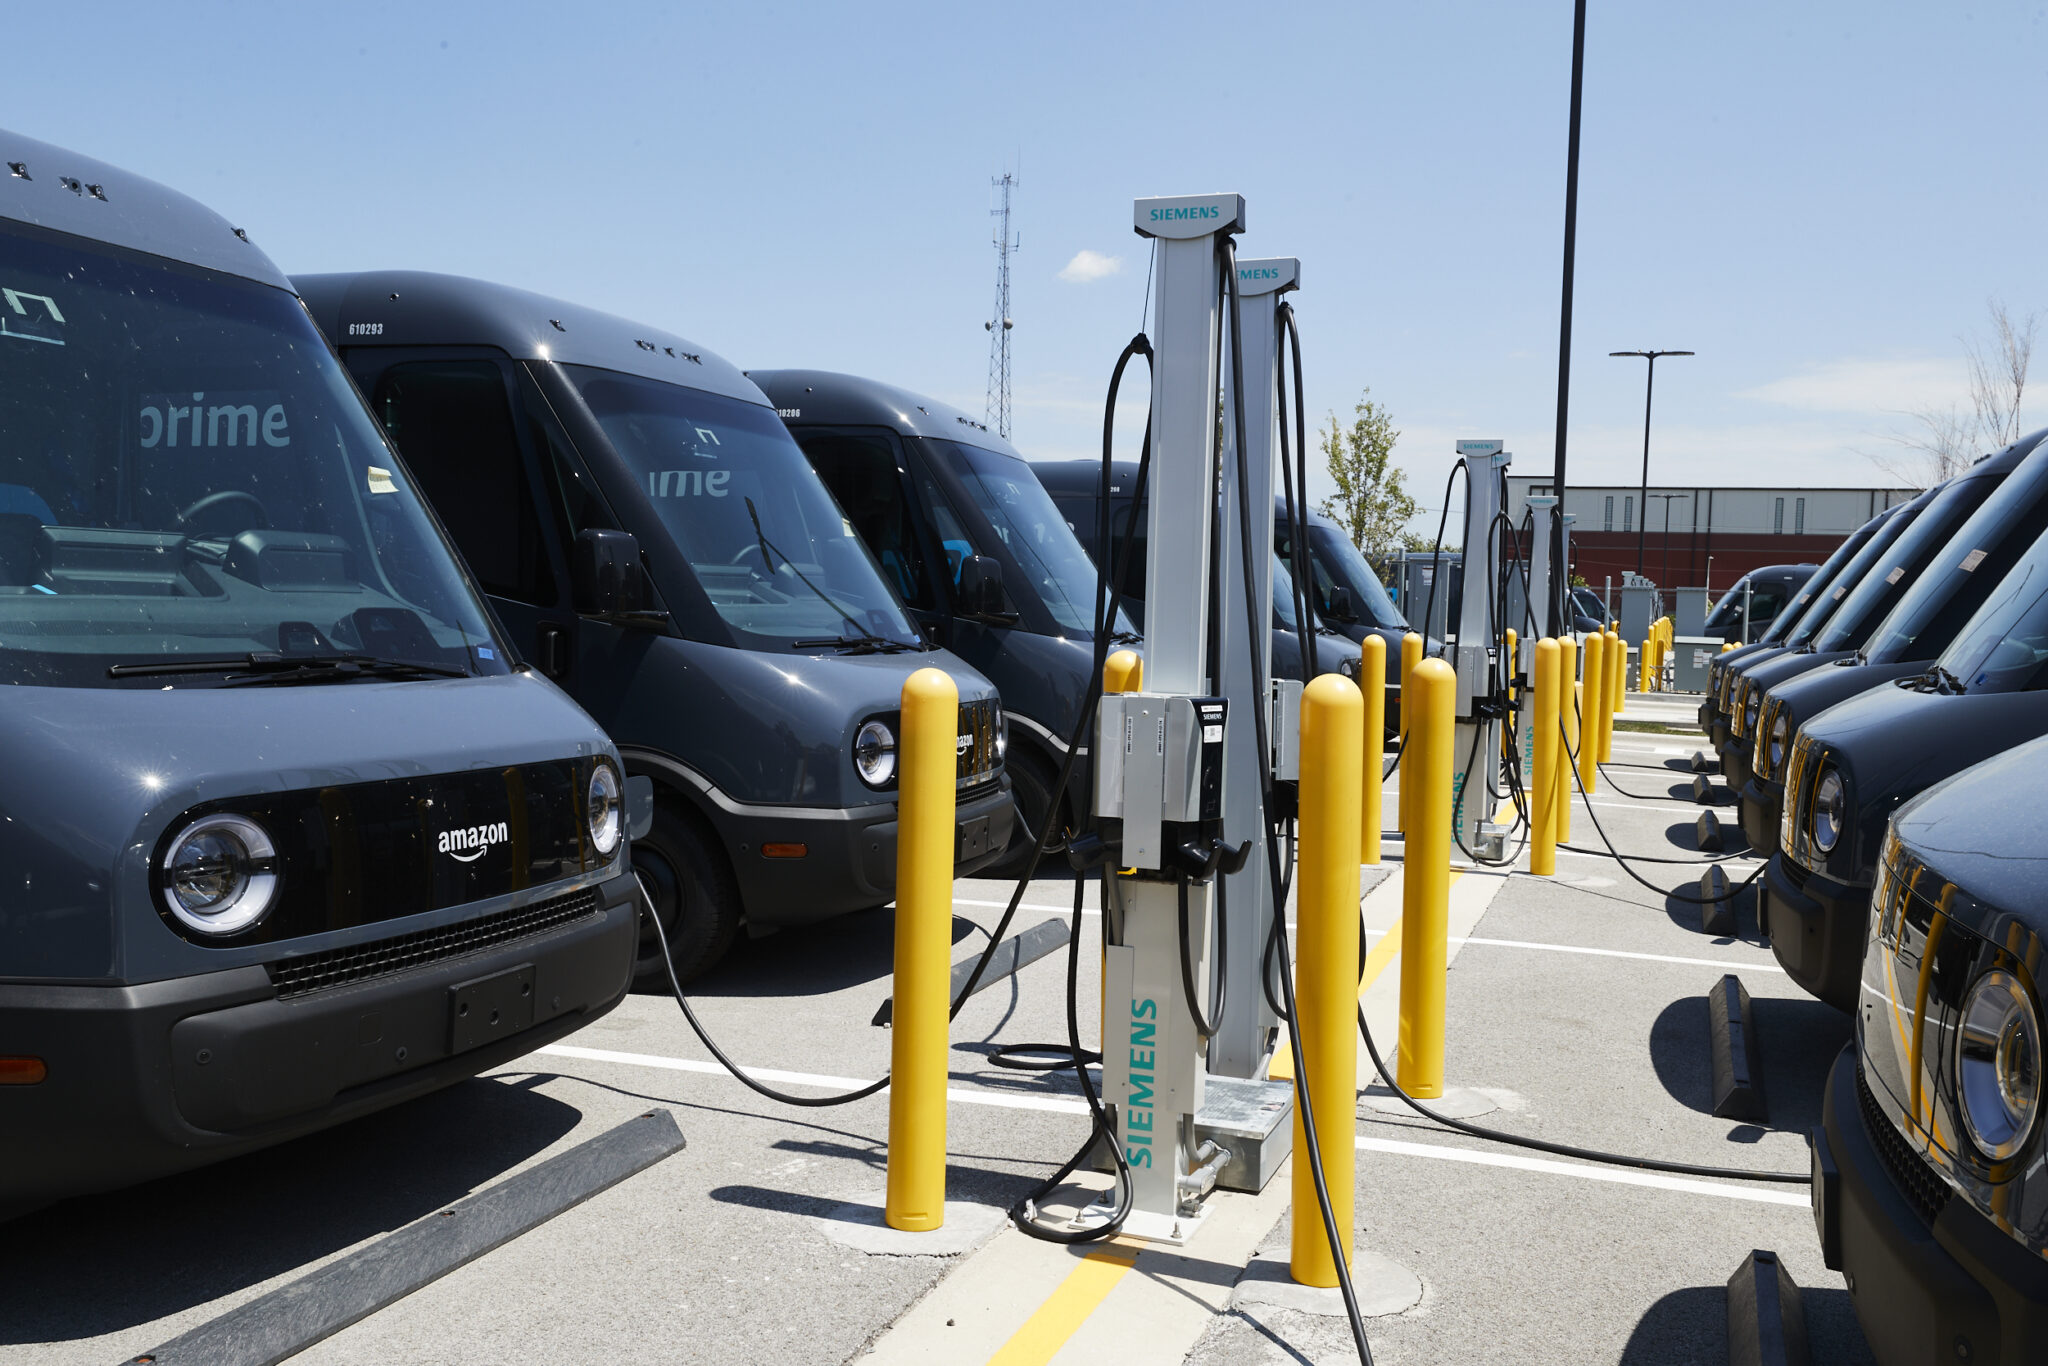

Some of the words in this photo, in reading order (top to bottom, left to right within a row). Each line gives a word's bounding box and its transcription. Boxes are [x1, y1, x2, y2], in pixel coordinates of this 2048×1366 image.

[1150, 206, 1219, 221] SIEMENS
[1236, 268, 1279, 280] MENS
[349, 323, 383, 335] 610293
[140, 391, 290, 448] prime
[778, 408, 800, 418] 10206
[649, 470, 731, 498] ime
[957, 734, 974, 748] azon
[1523, 726, 1533, 776] SIEMENS
[438, 821, 508, 853] amazon
[1126, 999, 1157, 1168] SIEMENS
